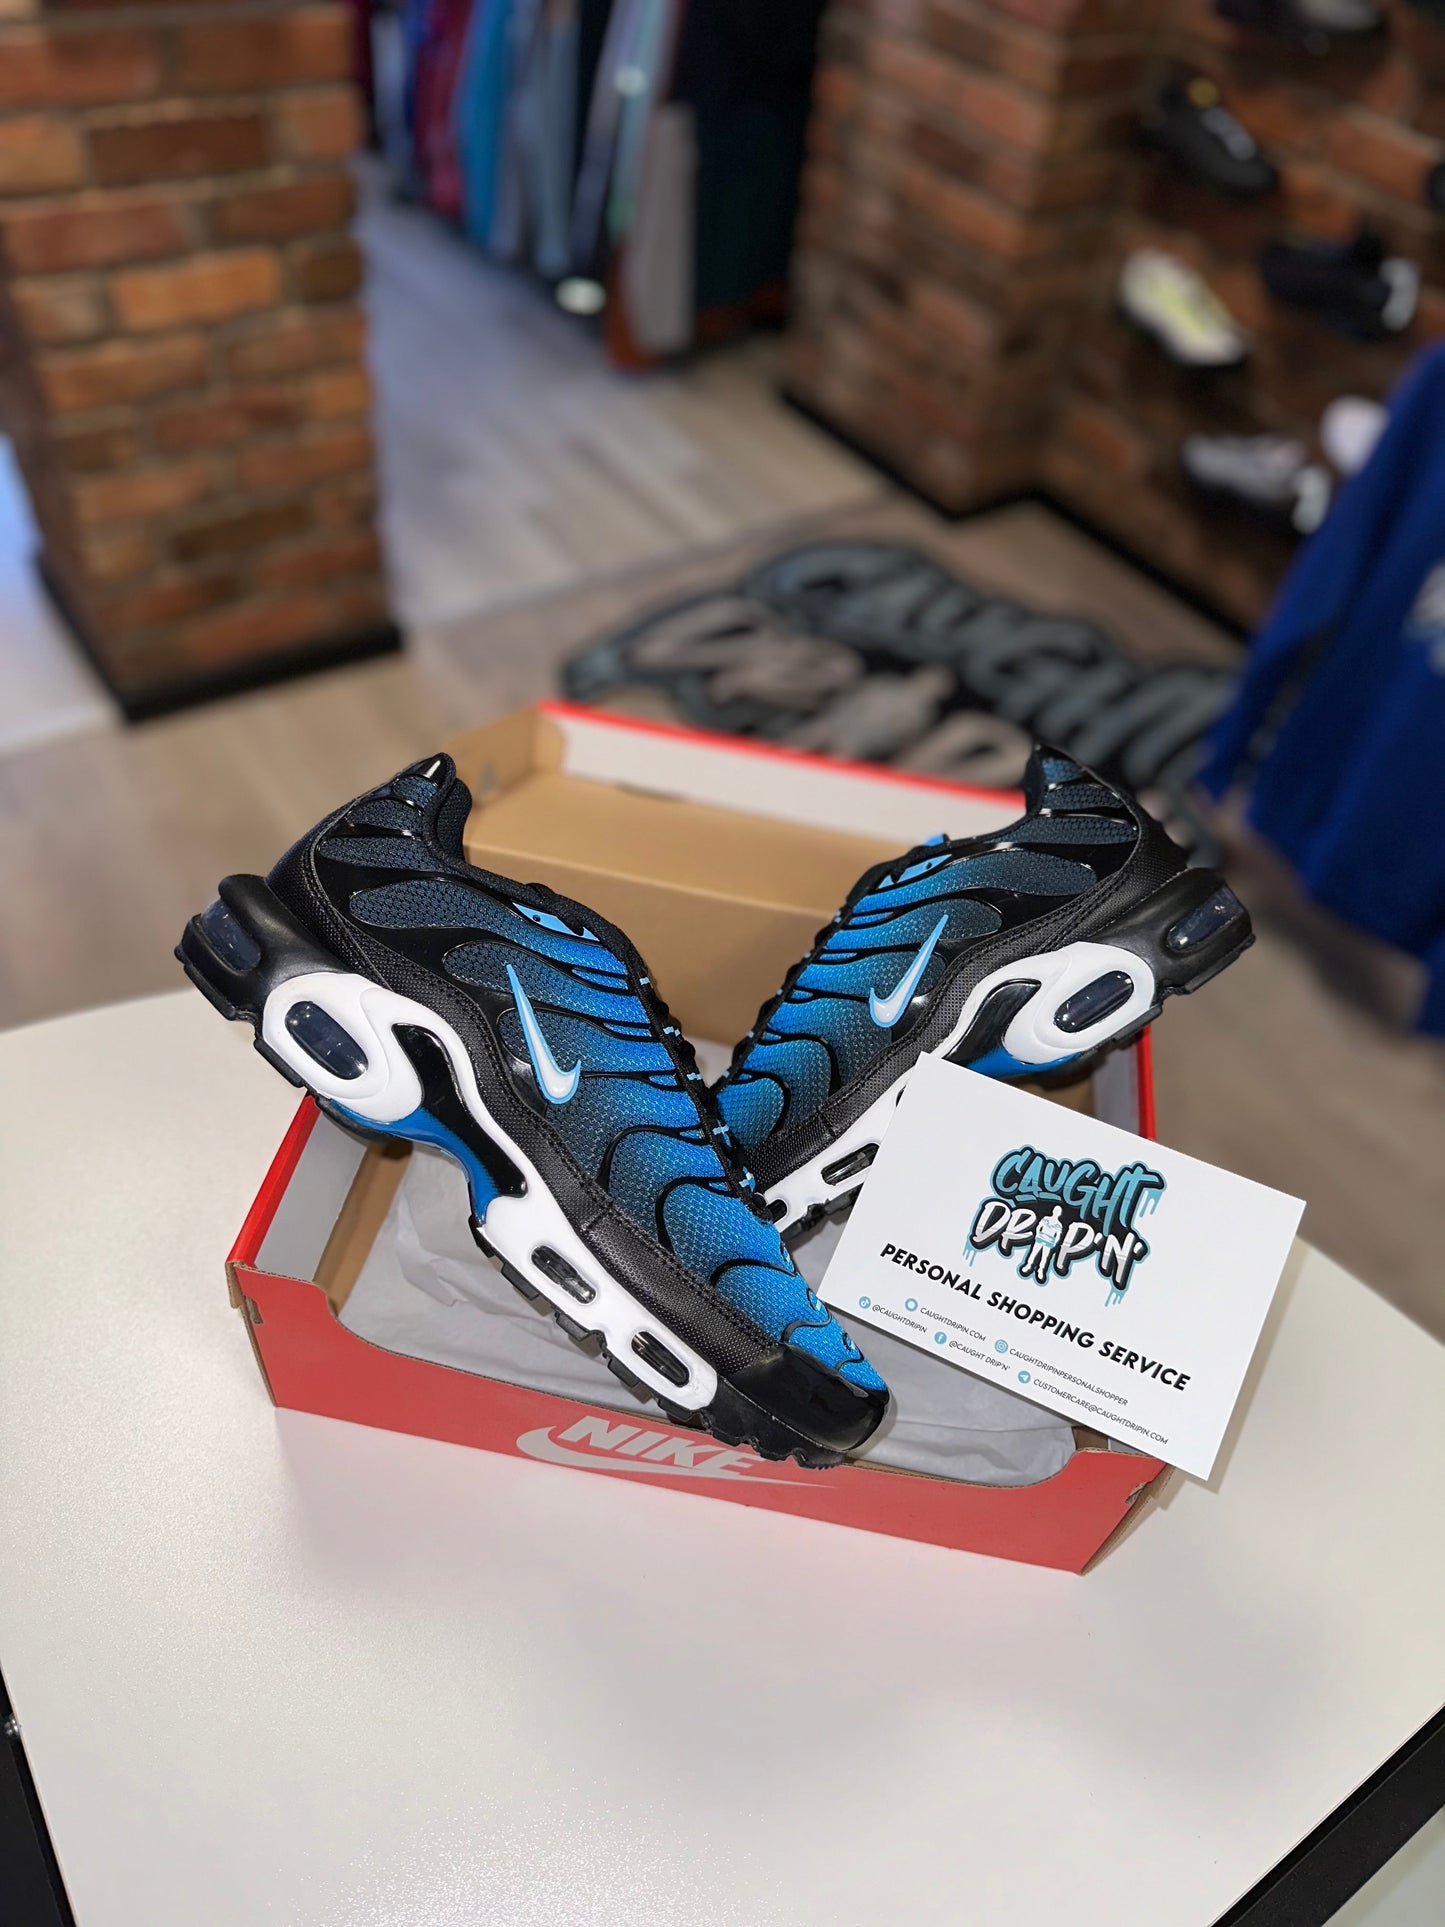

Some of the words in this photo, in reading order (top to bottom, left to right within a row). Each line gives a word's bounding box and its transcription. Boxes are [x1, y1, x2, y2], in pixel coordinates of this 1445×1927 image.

[996, 1149, 1158, 1236] CAUGHT
[872, 1304, 928, 1333] @CAUGHTDRIPIN
[880, 1243, 981, 1300] PERSONAL
[987, 1291, 1094, 1348] SHOPPING
[1098, 1341, 1191, 1390] SERVICE
[920, 1307, 987, 1342] CAUGHTDRIPIN.COM
[949, 1340, 985, 1360] @CAUGHT
[1009, 1348, 1129, 1406] CAUGHTDRIPINPERSONALSHOPPER
[1033, 1378, 1169, 1444] CUSTOMERCARE@CAUGHTDRIPIN.COM
[557, 1415, 767, 1476] NIKE
